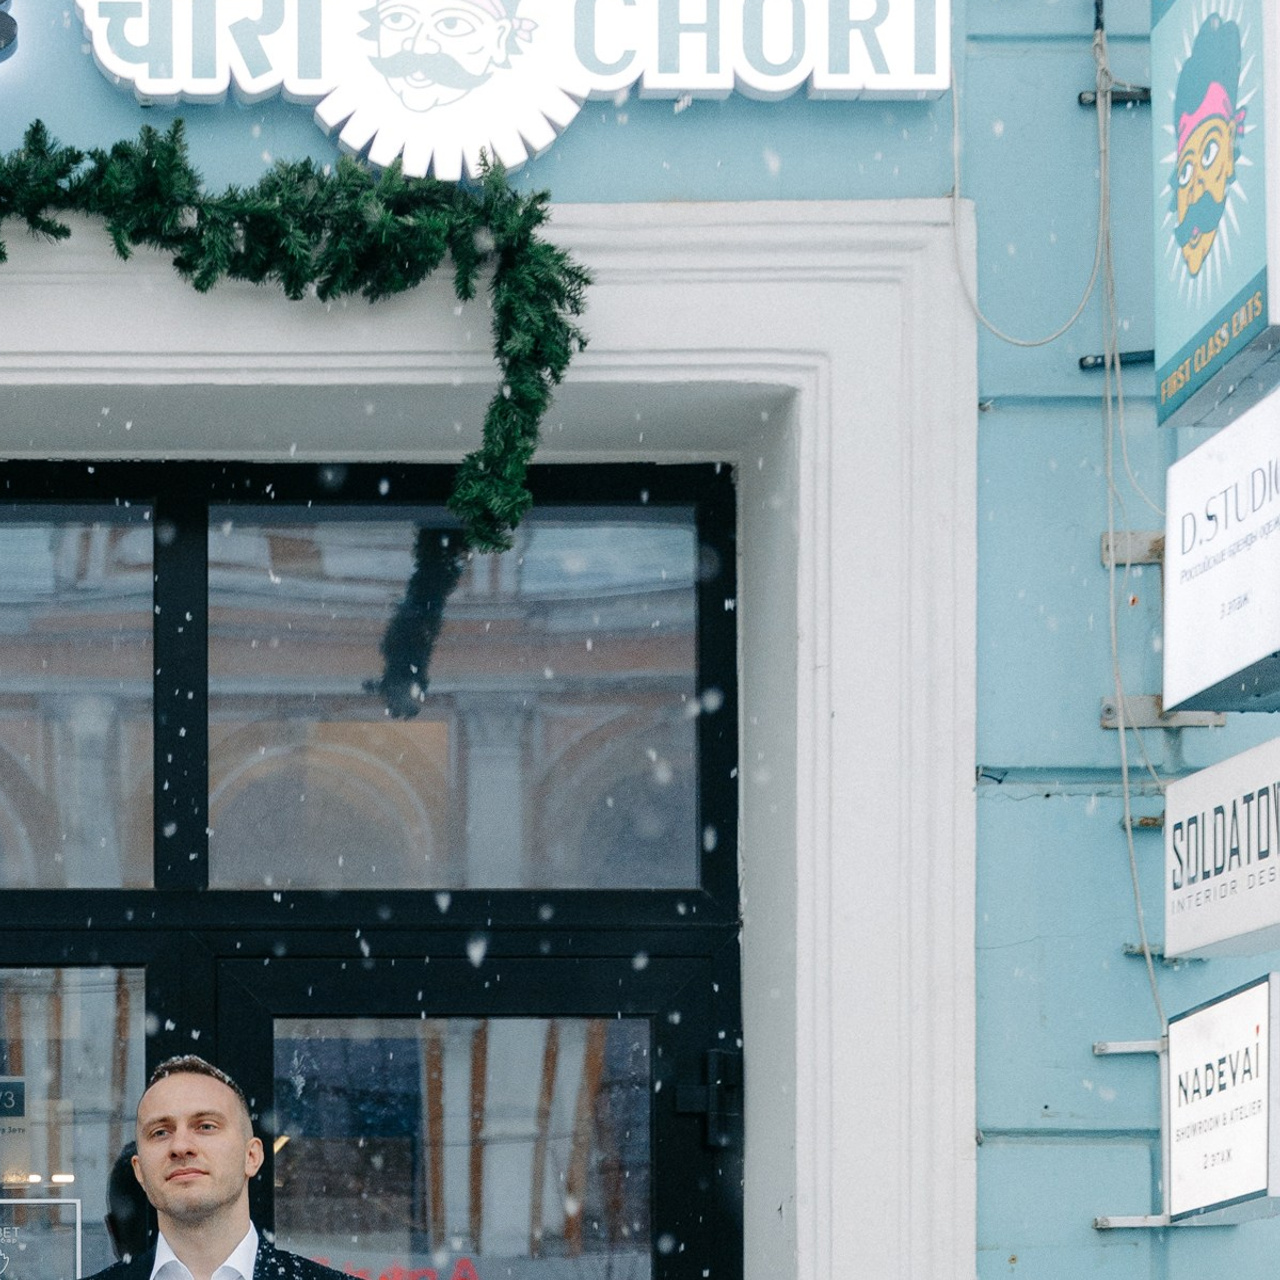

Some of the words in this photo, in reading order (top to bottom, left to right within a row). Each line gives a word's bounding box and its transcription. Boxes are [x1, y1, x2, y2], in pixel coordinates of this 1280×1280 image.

[572, 0, 949, 77] CHORI
[1160, 357, 1192, 405] FIRST
[1193, 322, 1230, 374] CLASS
[1231, 291, 1263, 338] EATS
[1181, 457, 1280, 556] D.STUDI
[1171, 880, 1239, 913] INTERIOR
[1175, 1115, 1220, 1142] SHOWROOM
[1229, 1099, 1262, 1121] ATELIER
